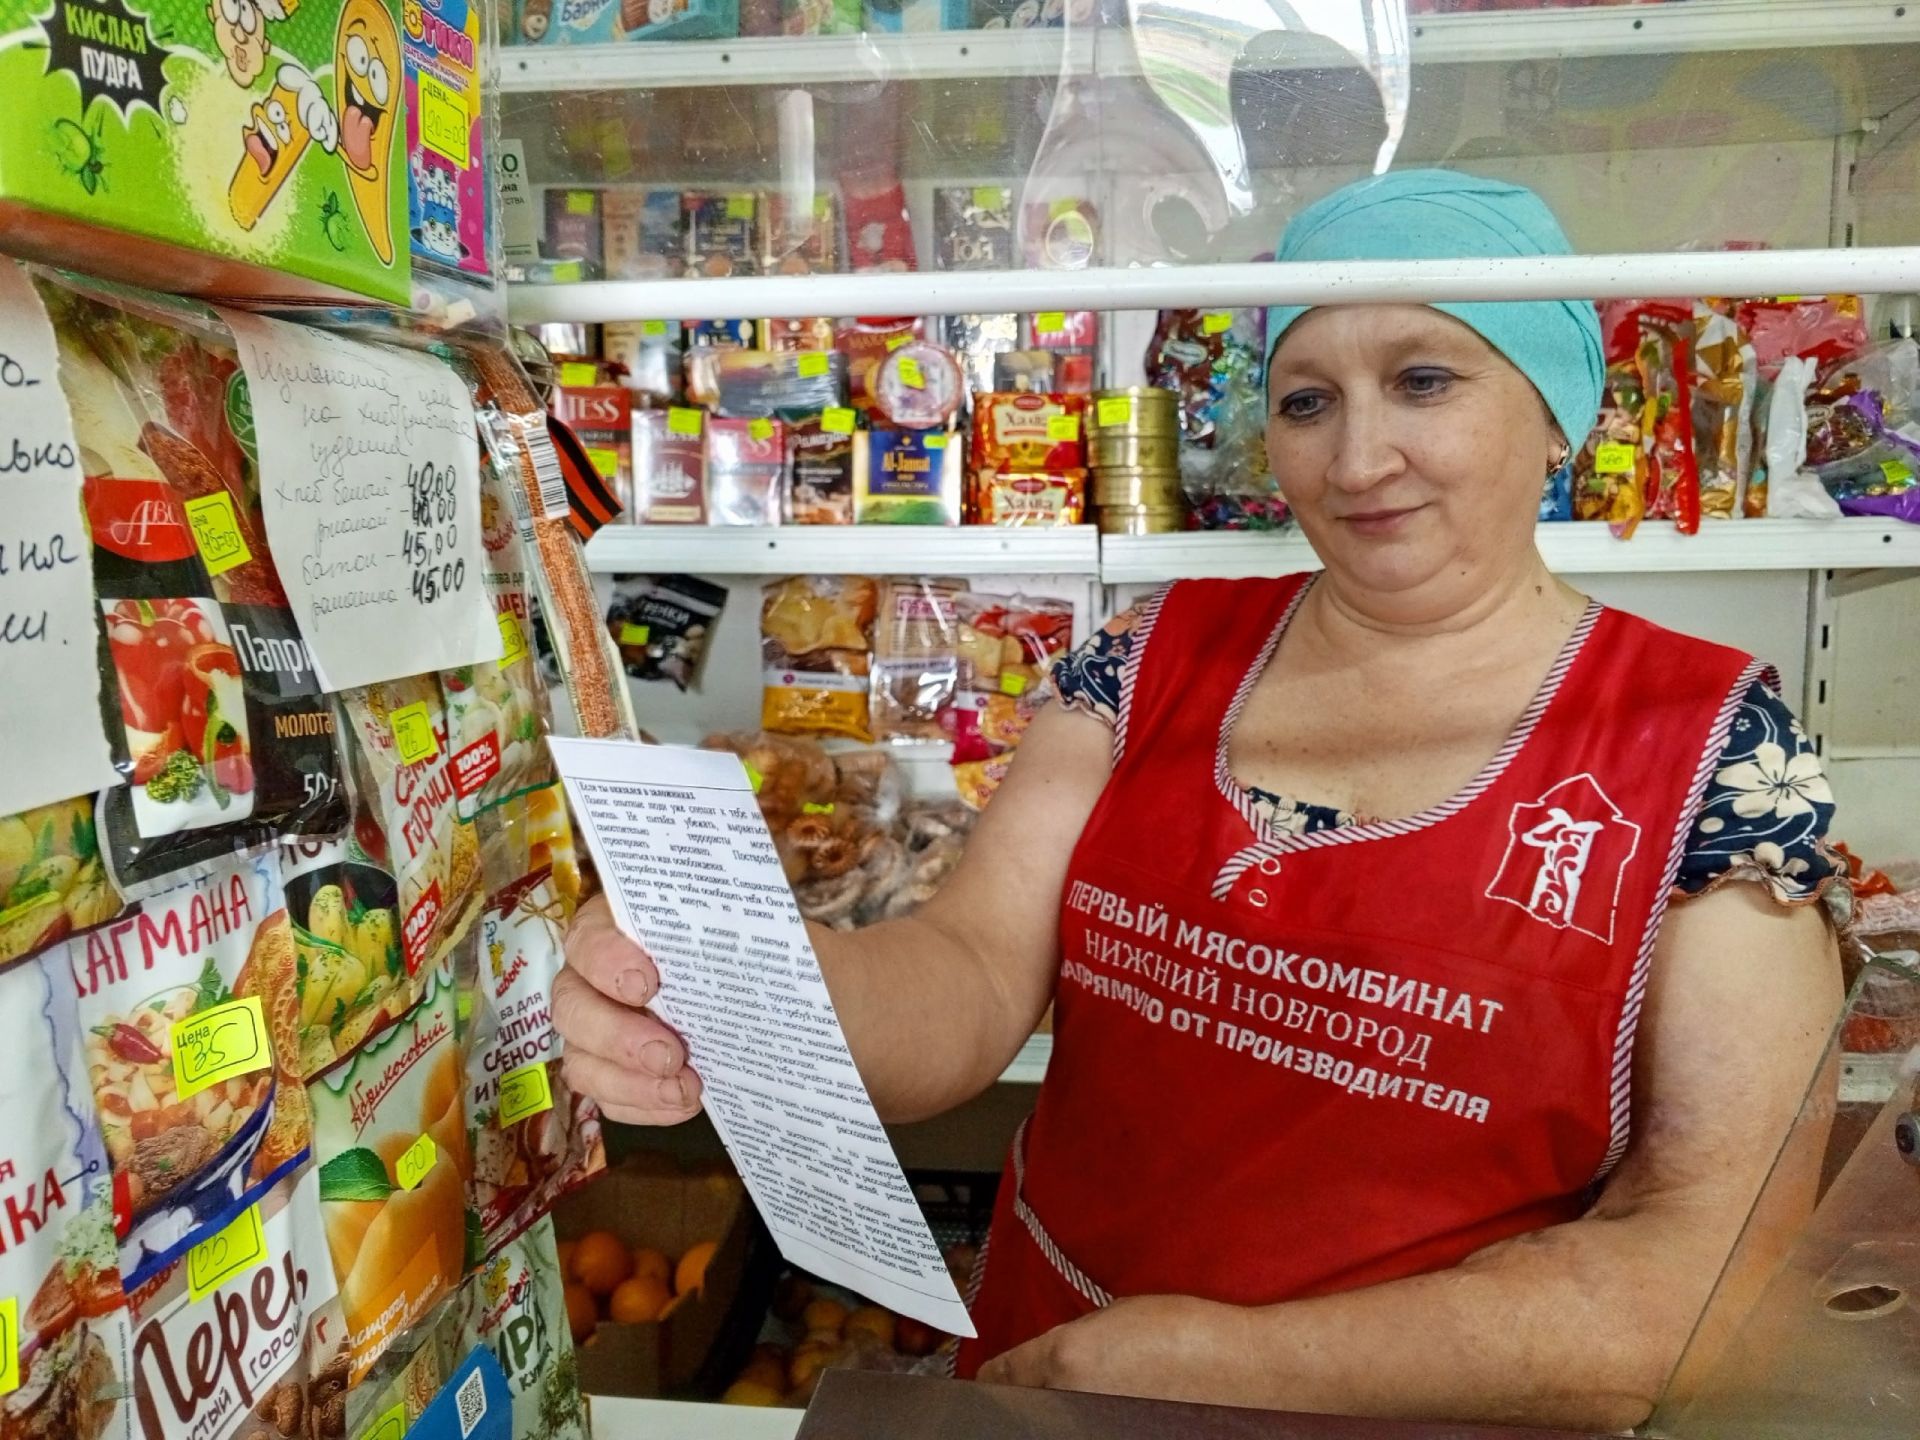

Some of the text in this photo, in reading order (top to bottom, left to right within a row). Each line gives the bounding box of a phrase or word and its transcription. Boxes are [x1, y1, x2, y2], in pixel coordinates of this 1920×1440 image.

[65, 3, 147, 54] КИСЛАЯ
[80, 44, 144, 91] ПУДРА
[274, 711, 336, 739] молота
[456, 742, 494, 774] 100%
[1066, 880, 1504, 1035] ПЕРВЫЙ МЯСОКОМБИНАТ
[1084, 928, 1433, 1071] НИЖНИЙ НОВГОРОД
[177, 1023, 211, 1049] Цена
[349, 1011, 448, 1133] Абрикосовый
[1169, 1007, 1212, 1039] ОТ
[1215, 1020, 1491, 1125] ПРОИЗВОДИТЕЛЯ
